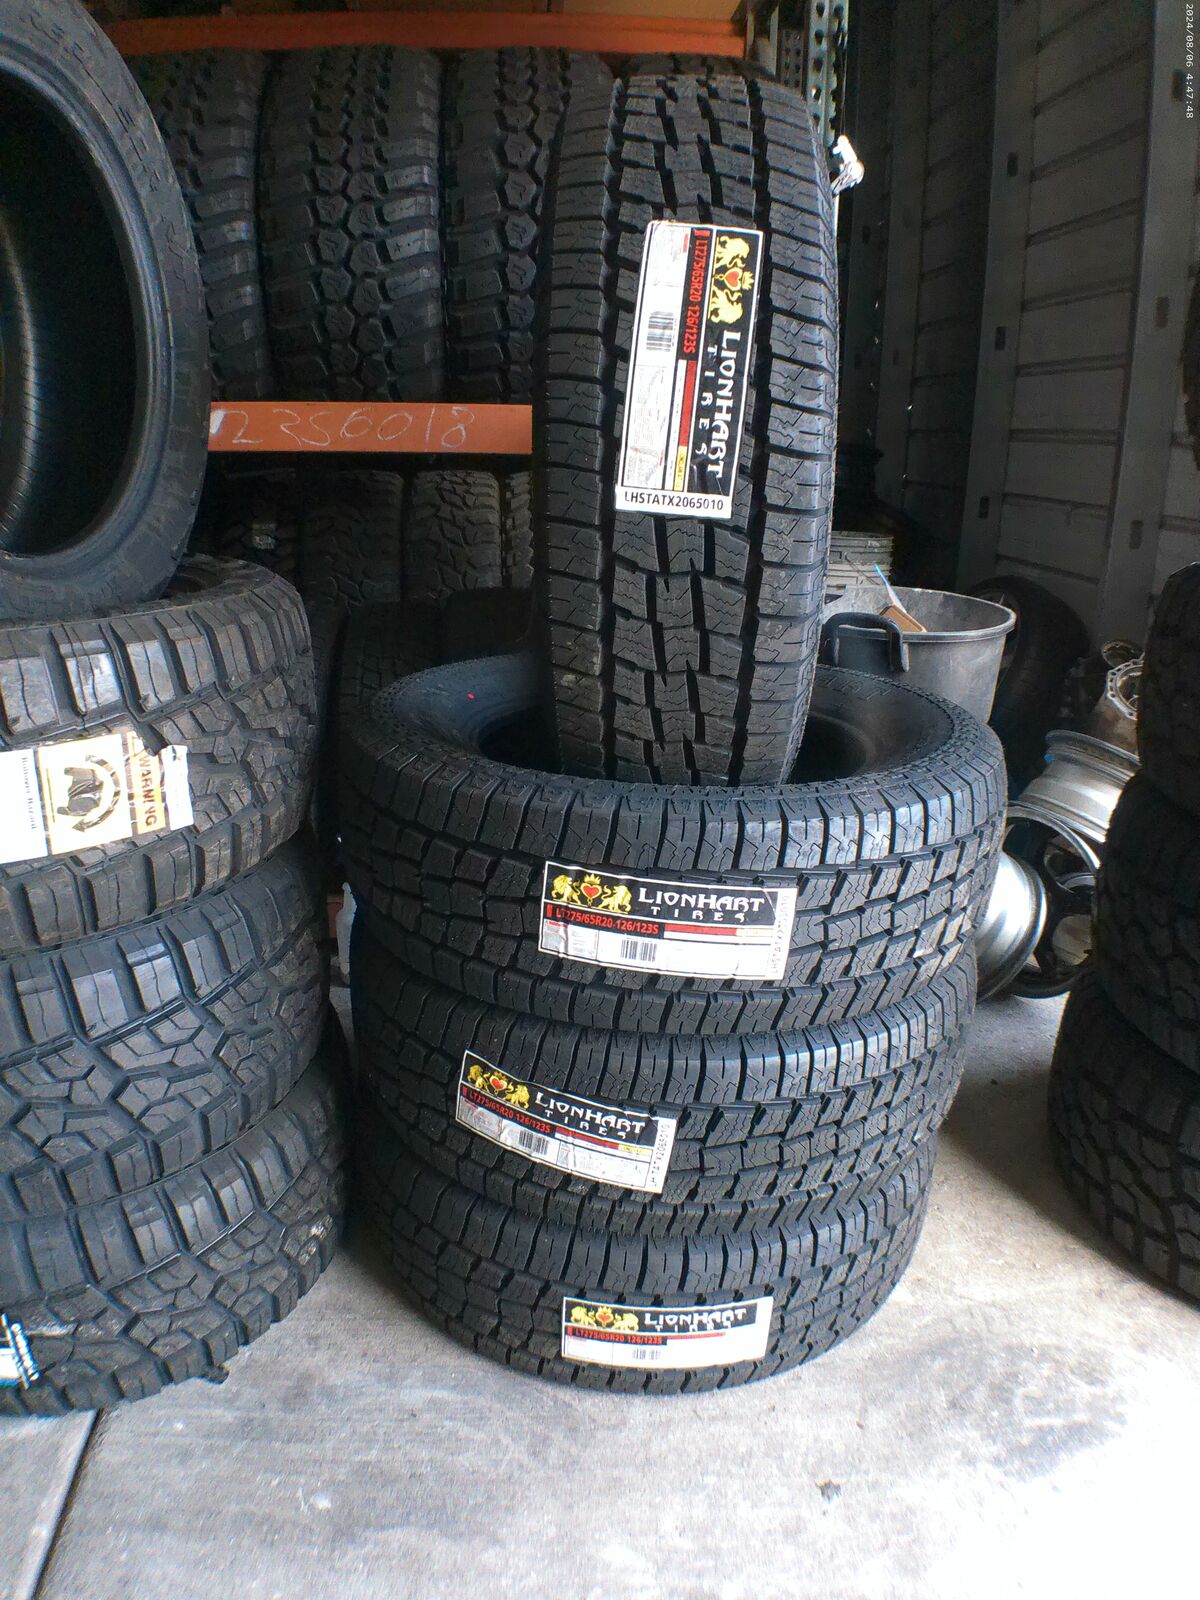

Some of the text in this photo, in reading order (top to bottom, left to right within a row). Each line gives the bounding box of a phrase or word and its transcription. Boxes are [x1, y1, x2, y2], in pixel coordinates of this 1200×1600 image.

[683, 239, 708, 353] LT275/65R20 126/123S
[696, 344, 718, 455] TIRES
[707, 330, 741, 478] LIONHART
[624, 490, 724, 511] LHSTATX2065010
[138, 753, 158, 827] WARNING
[556, 907, 659, 935] LT275/65R20 126/123S
[638, 887, 765, 912] LIONHART
[650, 906, 745, 922] TIRES
[469, 1088, 514, 1118] LT275/65R20
[515, 1112, 551, 1134] 126/123S
[535, 1091, 646, 1134] LIONHART
